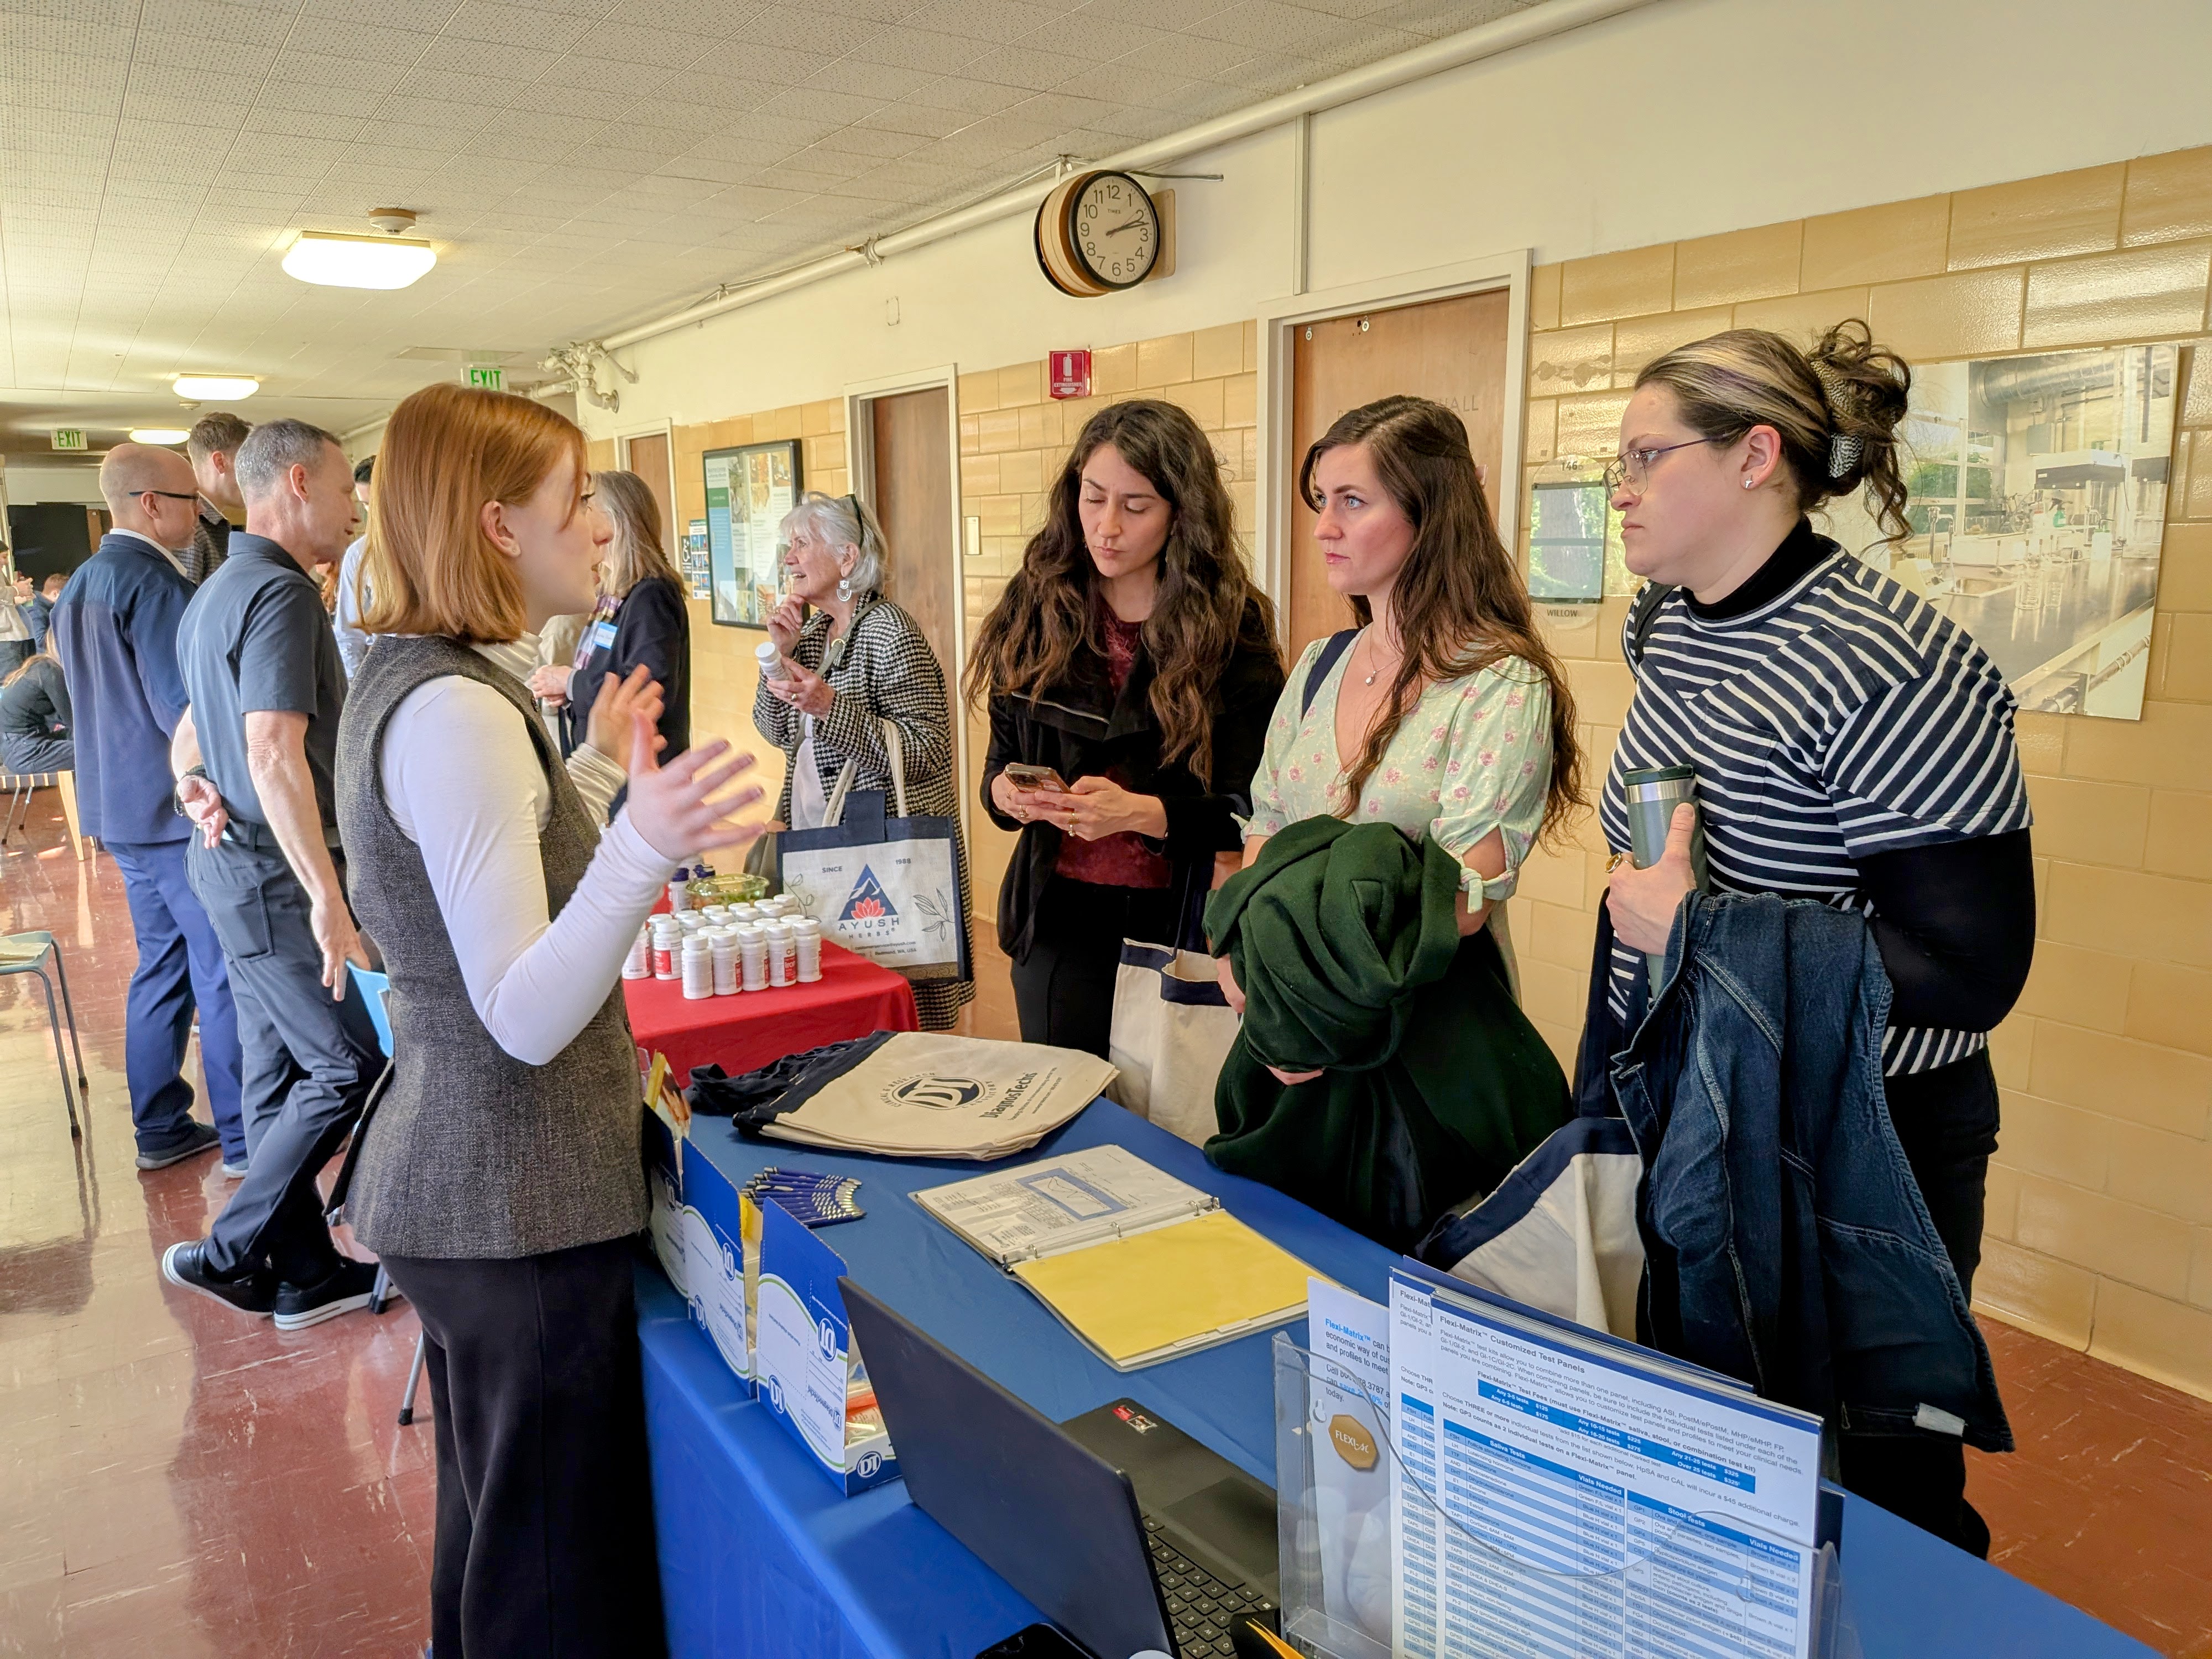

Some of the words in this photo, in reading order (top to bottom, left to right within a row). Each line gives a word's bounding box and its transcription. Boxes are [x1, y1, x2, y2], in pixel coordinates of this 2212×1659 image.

[1094, 190, 1103, 204] 11
[1107, 185, 1120, 199] 12
[1127, 194, 1131, 207] 1
[1084, 204, 1098, 219] 10
[1136, 209, 1145, 223] 2
[1081, 222, 1089, 237] 9
[1140, 228, 1149, 242] 3
[1086, 242, 1096, 257] 8
[1135, 247, 1145, 260] 4
[1097, 256, 1106, 270] 7
[1112, 262, 1121, 276] 6
[1126, 258, 1135, 272] 5
[470, 369, 501, 390] EXIT
[1439, 395, 1479, 412] HALL
[58, 431, 81, 447] EXIT
[838, 917, 899, 931] AYUSH
[888, 1072, 935, 1087] RESEARCH
[820, 1321, 835, 1357] DT
[1326, 1331, 1355, 1349] economic
[1357, 1345, 1369, 1357] way
[1373, 1340, 1384, 1350] can
[1326, 1342, 1337, 1352] and
[1339, 1348, 1361, 1363] profiles
[1364, 1358, 1370, 1366] to
[1372, 1362, 1388, 1375] meet
[1490, 1334, 1536, 1357] Customized
[1538, 1352, 1555, 1363] Test
[1557, 1358, 1584, 1374] Panels
[1326, 1363, 1338, 1376] Call
[1488, 1347, 1498, 1356] kits
[1499, 1352, 1514, 1362] allow
[1516, 1358, 1526, 1367] you
[1536, 1365, 1562, 1379] combine
[1563, 1375, 1579, 1385] more
[1581, 1380, 1594, 1390] than
[1596, 1386, 1608, 1395] one
[1610, 1390, 1629, 1402] panel,
[1631, 1397, 1661, 1413] including
[1663, 1407, 1676, 1417] ASI,
[770, 1380, 783, 1410] DT
[1326, 1386, 1344, 1402] today.
[1441, 1344, 1458, 1357] panels
[1460, 1352, 1470, 1361] you
[1481, 1360, 1512, 1378] combining.
[1554, 1387, 1573, 1399] allows
[1575, 1395, 1587, 1404] you
[1596, 1401, 1628, 1417] customize
[1630, 1413, 1641, 1421] test
[1644, 1417, 1665, 1430] panels
[1667, 1425, 1679, 1434] and
[1682, 1430, 1706, 1444] profiles
[1717, 1442, 1733, 1453] meet
[1736, 1449, 1751, 1459] your
[1753, 1453, 1776, 1467] clinical
[1780, 1462, 1804, 1475] needs.
[1468, 1347, 1478, 1356] and
[1517, 1365, 1534, 1377] When
[1536, 1373, 1567, 1389] combining
[1569, 1384, 1591, 1397] panels,
[1603, 1397, 1616, 1405] sure
[1627, 1403, 1650, 1416] include
[1652, 1412, 1662, 1420] the
[1664, 1416, 1695, 1432] individual
[1698, 1427, 1713, 1437] tests
[1715, 1433, 1733, 1444] listed
[1735, 1439, 1755, 1452] under
[1758, 1447, 1774, 1457] each
[1786, 1455, 1797, 1464] the
[1518, 1386, 1531, 1395] Test
[1532, 1391, 1547, 1401] Fees
[1549, 1397, 1567, 1409] (must
[1629, 1425, 1650, 1438] saliva,
[1652, 1433, 1671, 1444] stool,
[1682, 1443, 1726, 1463] combination
[1729, 1459, 1742, 1468] test
[1744, 1463, 1755, 1474] kit)
[1443, 1401, 1458, 1412] Note:
[1459, 1407, 1471, 1418] GP3
[1473, 1414, 1493, 1426] counts
[1507, 1427, 1537, 1444] individual
[1538, 1440, 1554, 1450] tests
[1616, 1468, 1636, 1481] panel.
[1490, 1439, 1507, 1452] Saliva
[1509, 1448, 1525, 1459] Tests
[1442, 1391, 1463, 1405] Choose
[1464, 1400, 1484, 1413] THREE
[1494, 1413, 1509, 1423] more
[1511, 1419, 1538, 1434] individual
[1540, 1430, 1553, 1439] tests
[1555, 1436, 1569, 1446] from
[1571, 1441, 1580, 1449] the
[1582, 1445, 1590, 1453] list
[1592, 1449, 1612, 1461] shown
[1636, 1464, 1655, 1477] HpSA
[1656, 1472, 1669, 1481] and
[1671, 1477, 1684, 1486] CAL
[1687, 1482, 1697, 1491] will
[1699, 1487, 1715, 1498] incur
[1723, 1495, 1735, 1505] $45
[1738, 1500, 1771, 1517] additional
[860, 1455, 879, 1475] DT
[1578, 1474, 1594, 1485] Vials
[1596, 1480, 1621, 1495] Needed
